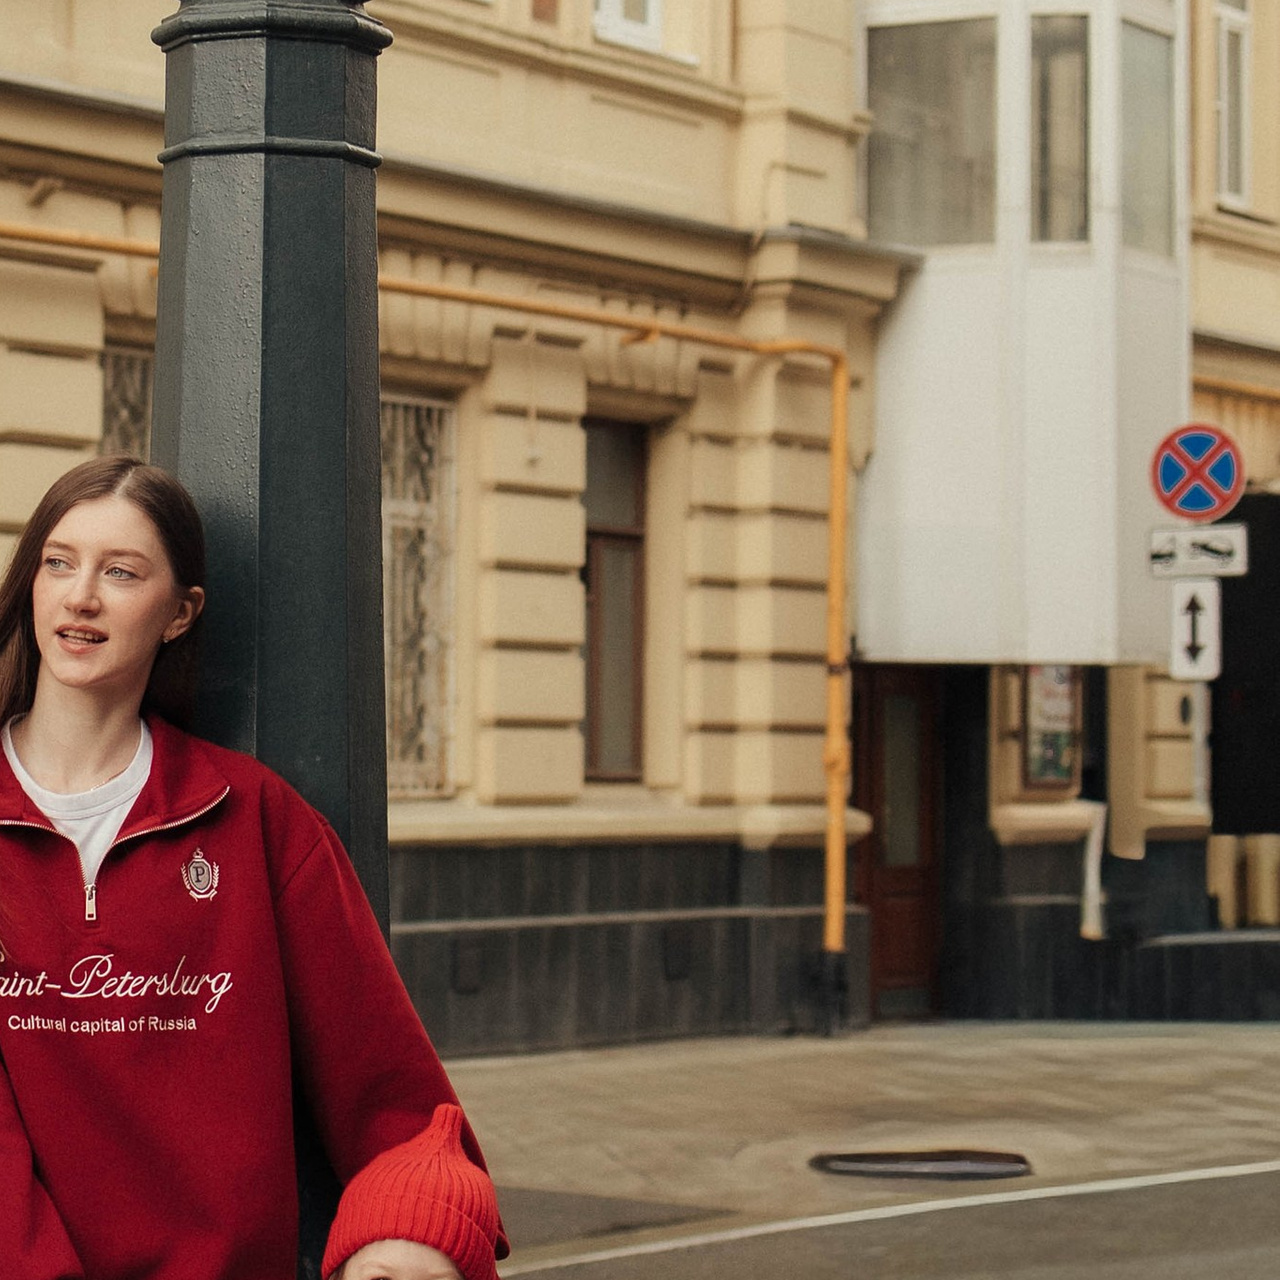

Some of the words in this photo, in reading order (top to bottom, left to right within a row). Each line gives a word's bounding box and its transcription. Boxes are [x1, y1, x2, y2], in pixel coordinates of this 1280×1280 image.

[7, 1015, 66, 1032] Cultural
[70, 1017, 125, 1036] capital
[128, 1017, 145, 1032] of
[148, 1016, 197, 1032] Russia
